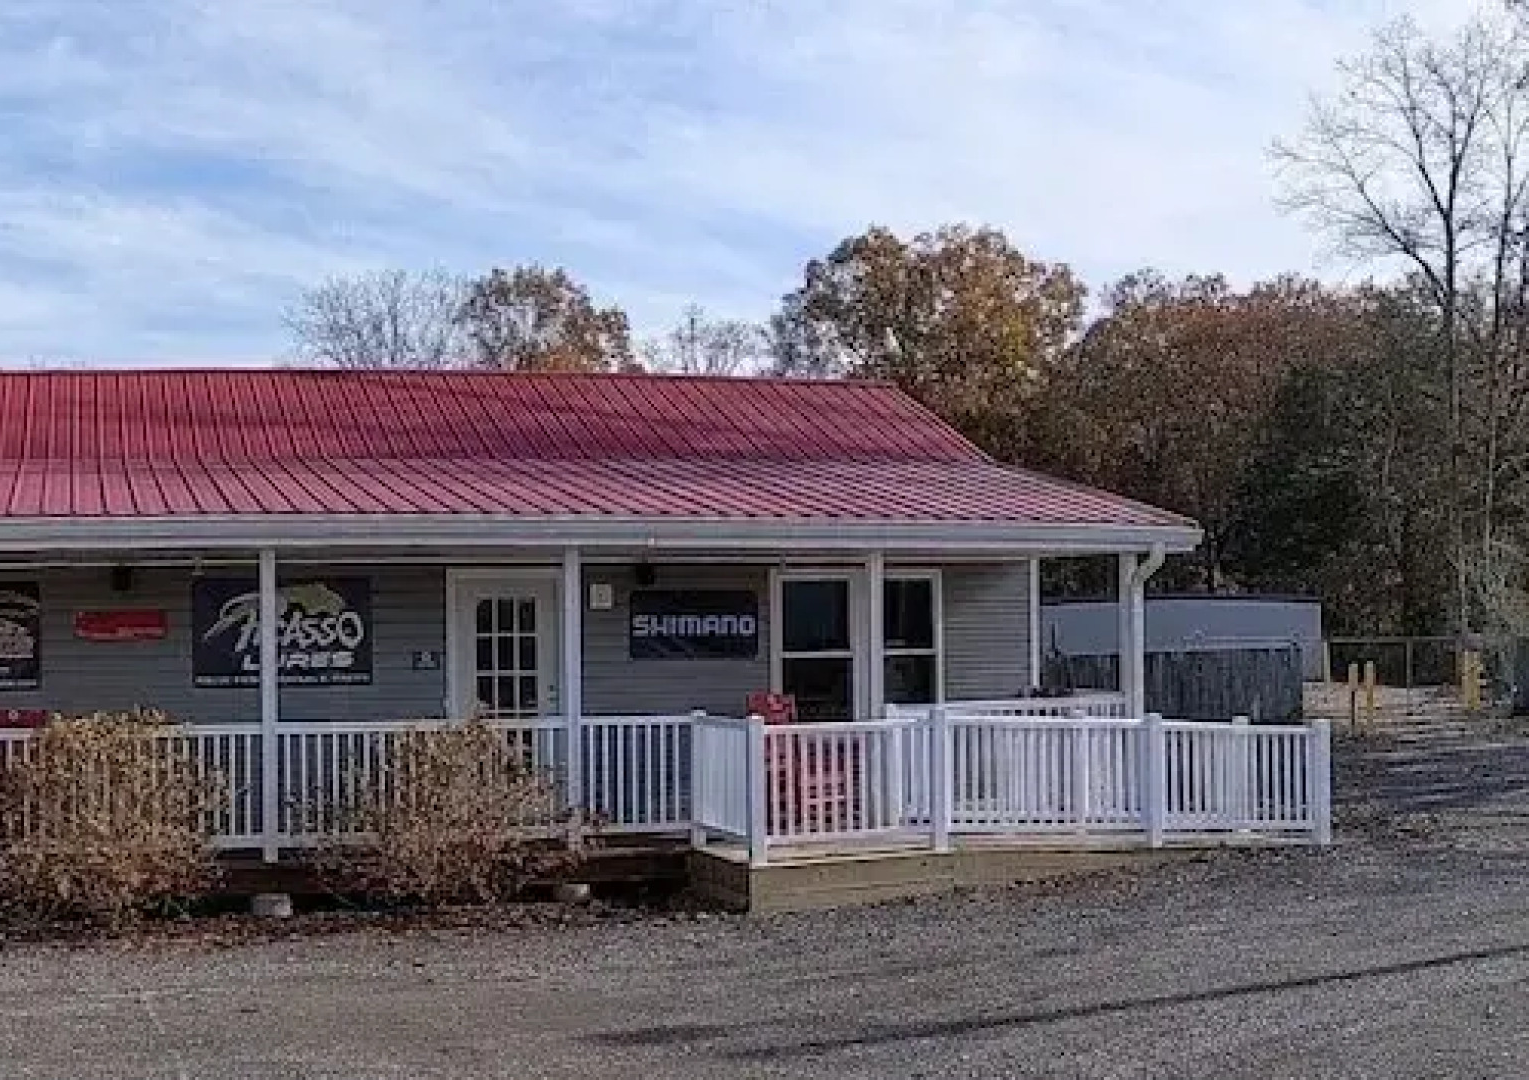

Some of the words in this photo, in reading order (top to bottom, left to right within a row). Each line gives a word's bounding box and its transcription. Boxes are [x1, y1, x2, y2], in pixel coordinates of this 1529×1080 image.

[204, 591, 364, 650] PIASSO
[632, 614, 756, 637] SHIMANO
[242, 651, 355, 671] LRES
